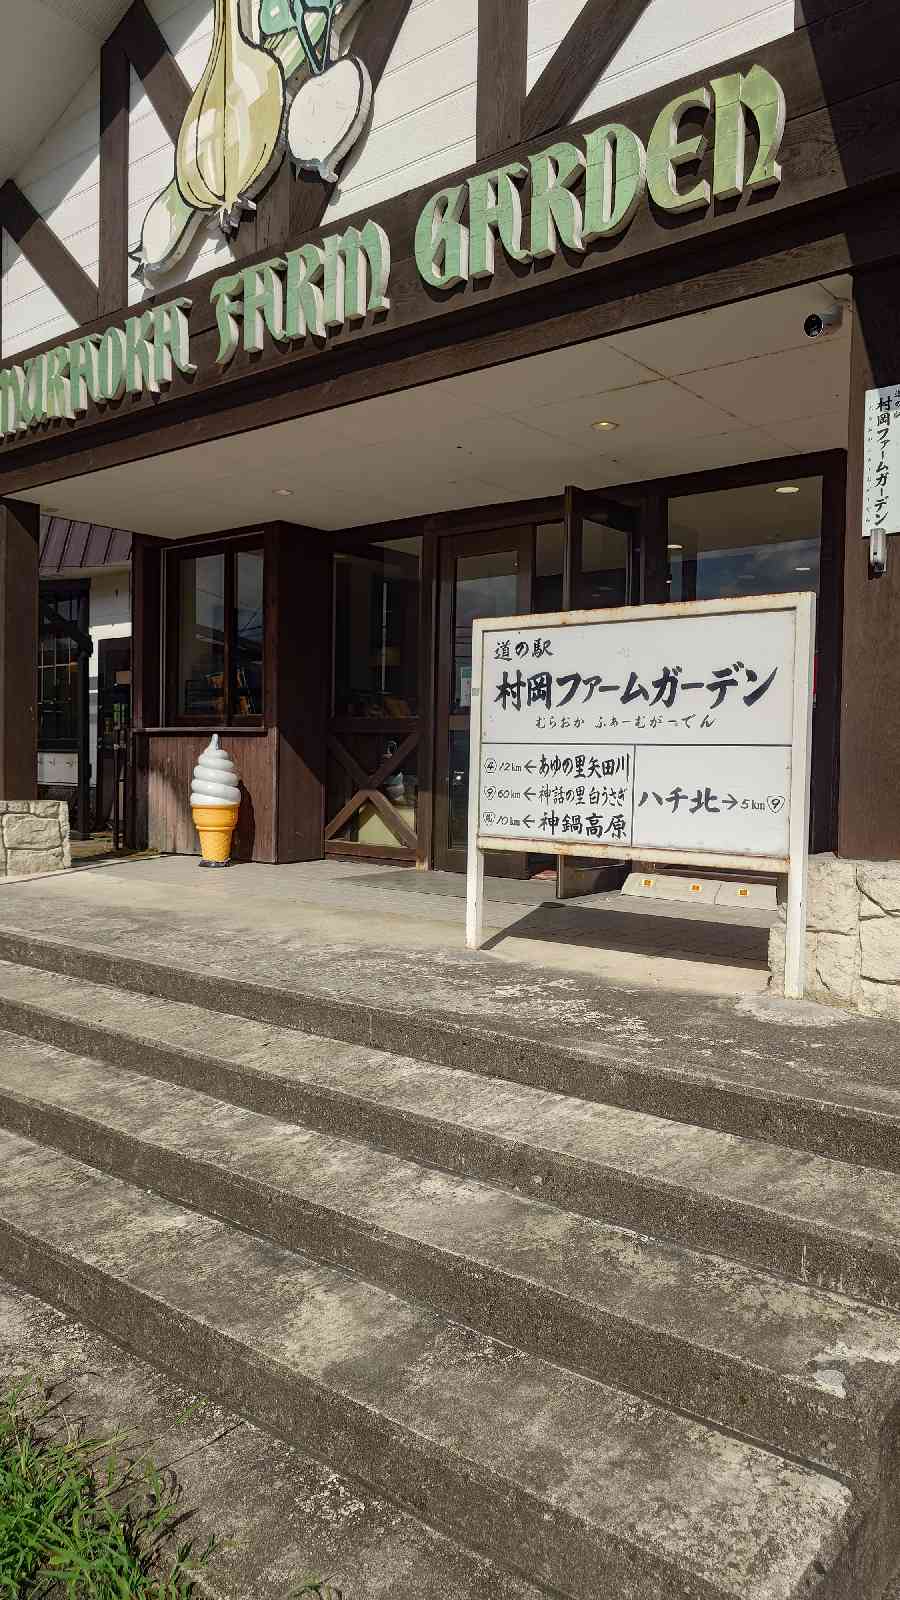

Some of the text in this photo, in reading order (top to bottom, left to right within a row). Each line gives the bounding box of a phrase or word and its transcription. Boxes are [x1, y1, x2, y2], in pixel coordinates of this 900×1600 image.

[209, 219, 390, 364] FARM
[414, 64, 786, 290] GARDEN
[874, 395, 892, 526] 村岡ファームガーデン
[494, 638, 555, 661] 道の駅
[494, 661, 778, 711] 村岡ファームガーデン
[535, 716, 585, 729] むらおか
[539, 753, 630, 782] あゆの里矢田川
[638, 786, 721, 814] ハチ北
[538, 809, 627, 839] 神鍋高原
